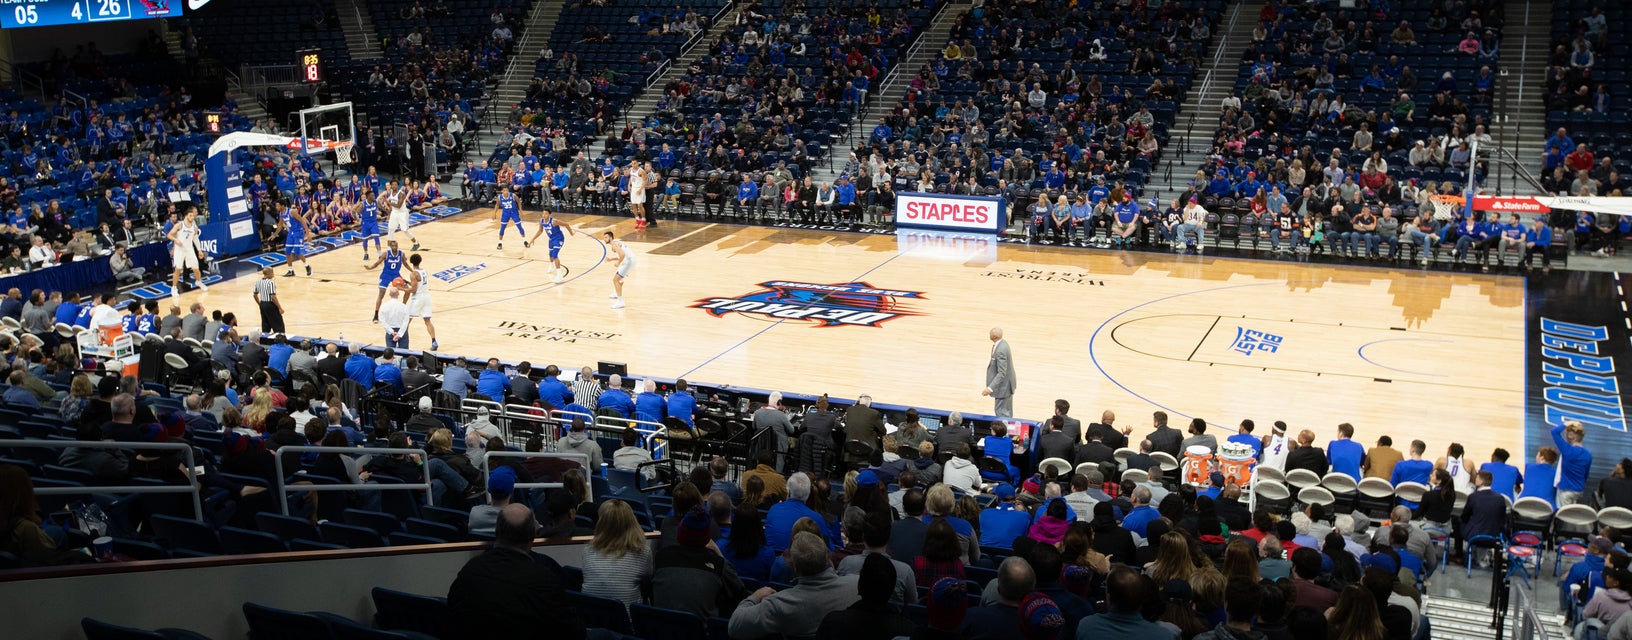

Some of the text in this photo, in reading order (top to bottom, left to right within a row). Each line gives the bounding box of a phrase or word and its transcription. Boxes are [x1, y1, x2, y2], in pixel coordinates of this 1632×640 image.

[15, 5, 38, 24] 05
[71, 2, 83, 20] 4
[98, 0, 121, 16] 26
[307, 65, 318, 80] 18
[906, 201, 989, 224] STAPLES
[1280, 217, 1292, 229] 51
[138, 320, 150, 332] 22
[1234, 328, 1264, 356] EAST
[1257, 333, 1284, 353] BIG
[1540, 316, 1628, 433] DEPAUL
[1273, 443, 1282, 455] 4
[1191, 460, 1200, 469] G
[1228, 465, 1237, 475] G
[1451, 465, 1459, 477] 0
